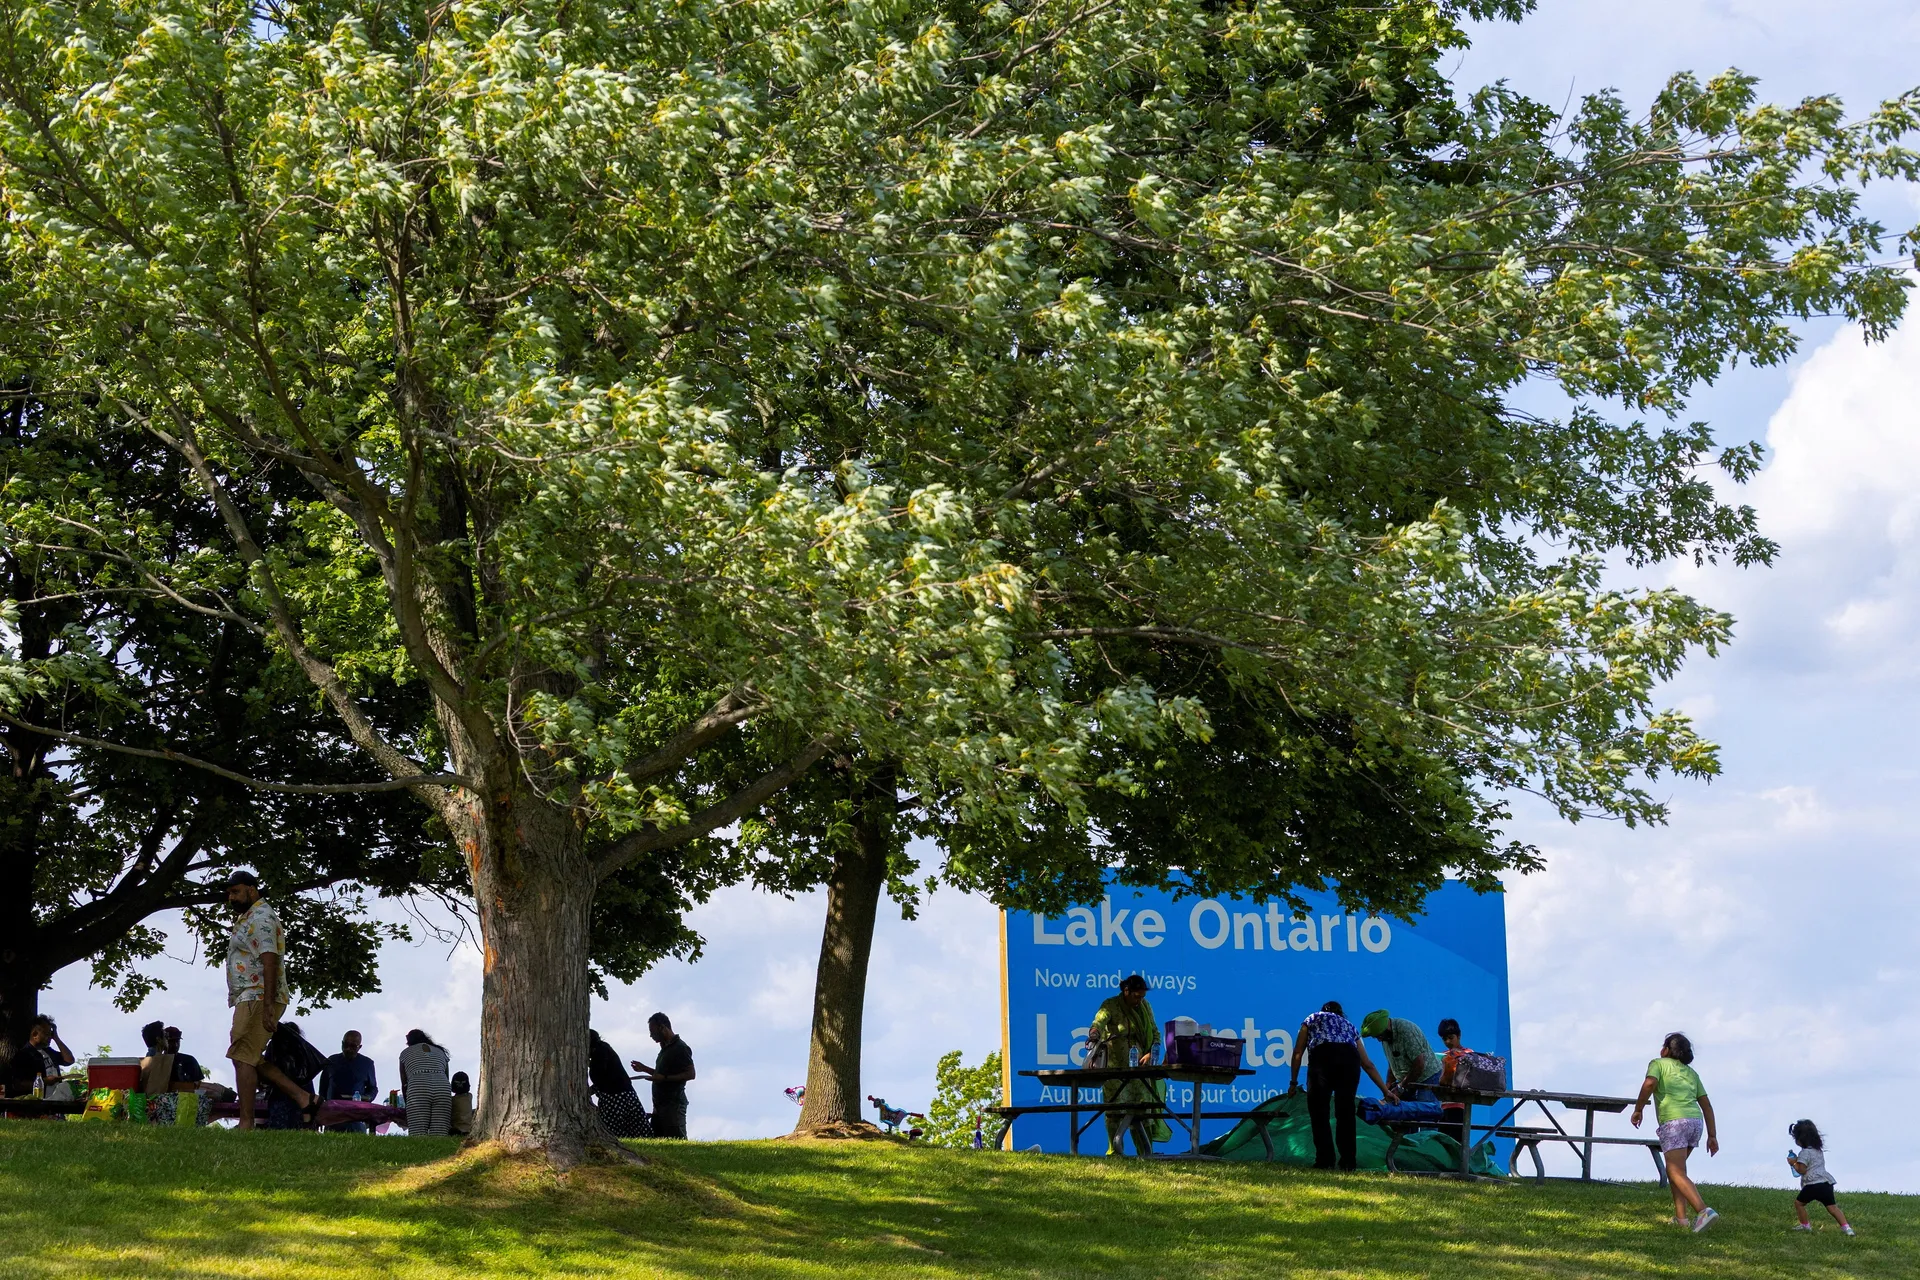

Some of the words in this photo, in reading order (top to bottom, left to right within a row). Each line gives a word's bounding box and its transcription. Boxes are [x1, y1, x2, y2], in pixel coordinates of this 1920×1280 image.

[1033, 894, 1166, 948] Lake
[1189, 899, 1391, 953] Ontario
[1035, 968, 1080, 988] Now
[1085, 970, 1121, 989] and
[1130, 970, 1197, 995] lways
